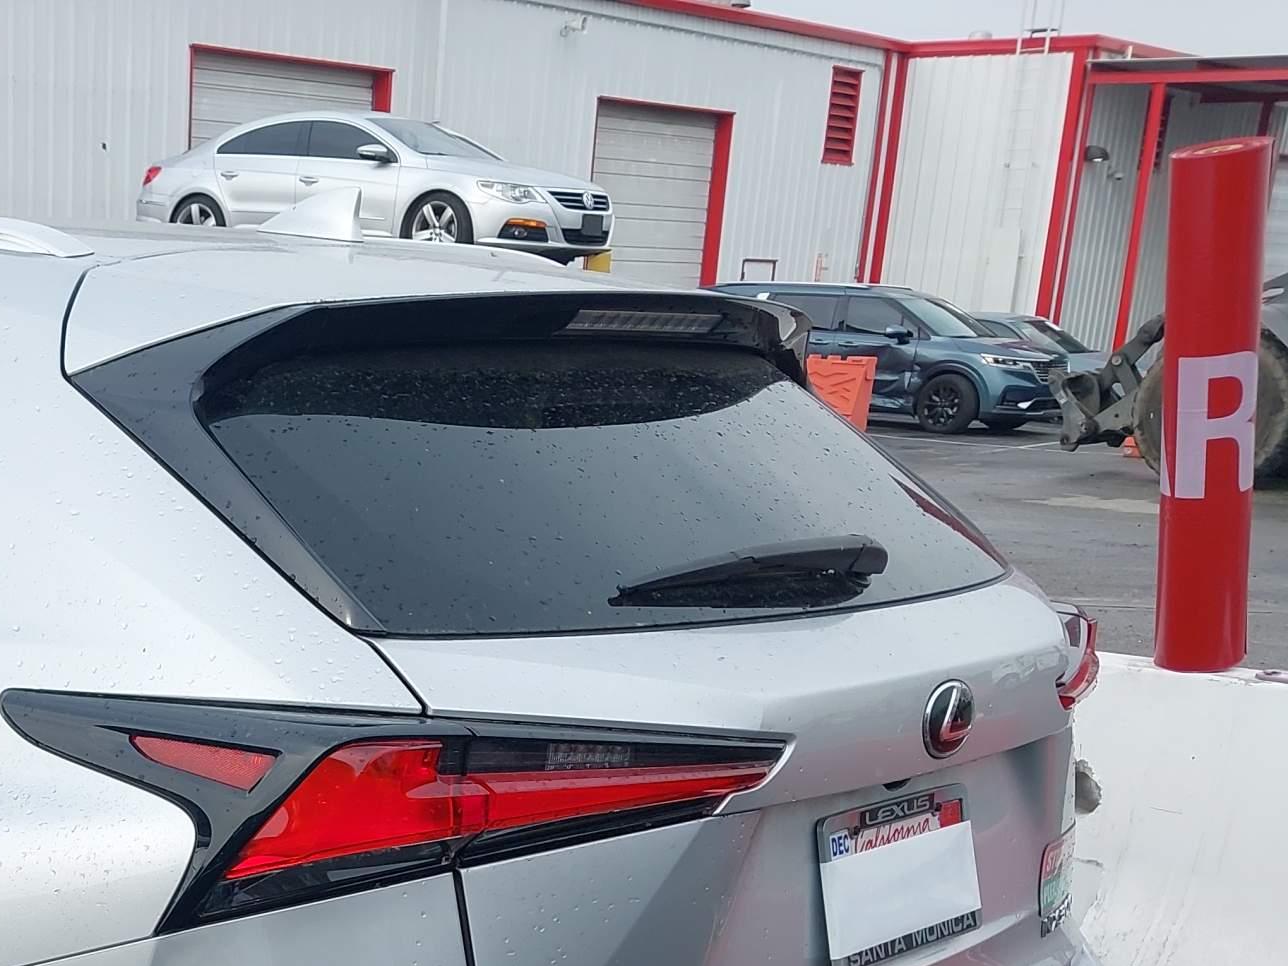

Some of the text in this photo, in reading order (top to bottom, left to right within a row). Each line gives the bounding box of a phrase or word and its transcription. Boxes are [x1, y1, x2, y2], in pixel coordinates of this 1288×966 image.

[1159, 351, 1258, 499] R
[865, 796, 930, 825] LEXUS
[831, 834, 850, 857] DEC
[854, 817, 931, 854] California
[912, 911, 975, 948] MONICA
